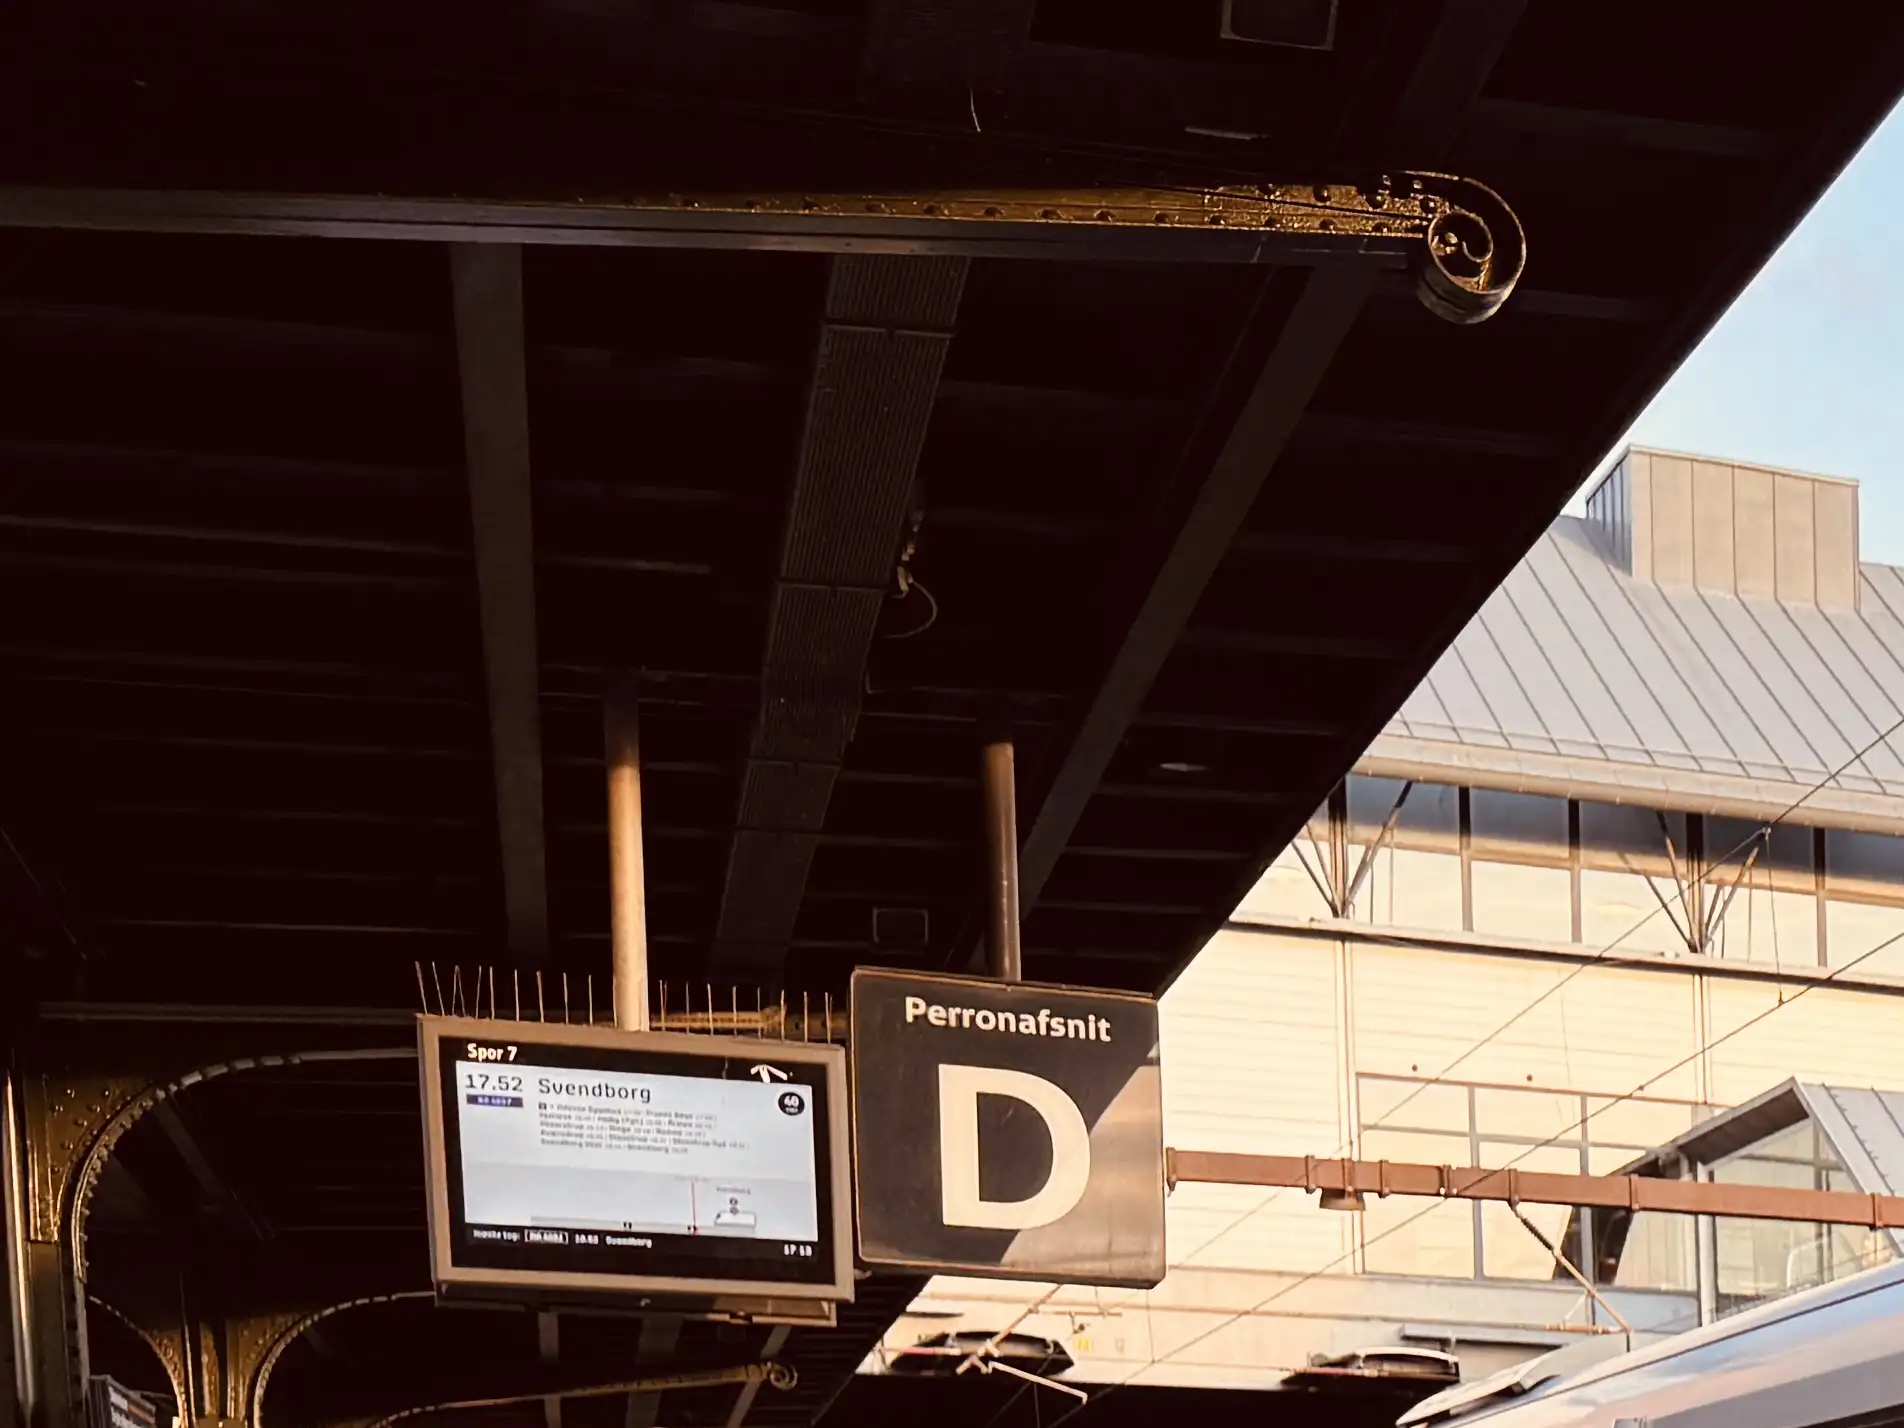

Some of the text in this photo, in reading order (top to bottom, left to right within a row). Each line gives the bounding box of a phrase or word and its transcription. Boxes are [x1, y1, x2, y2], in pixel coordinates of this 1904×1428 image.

[904, 996, 1112, 1042] Perronafsnit
[467, 1043, 518, 1062] Spor 7
[466, 1074, 651, 1103] 17.52 Svendborg
[938, 1063, 1092, 1231] D
